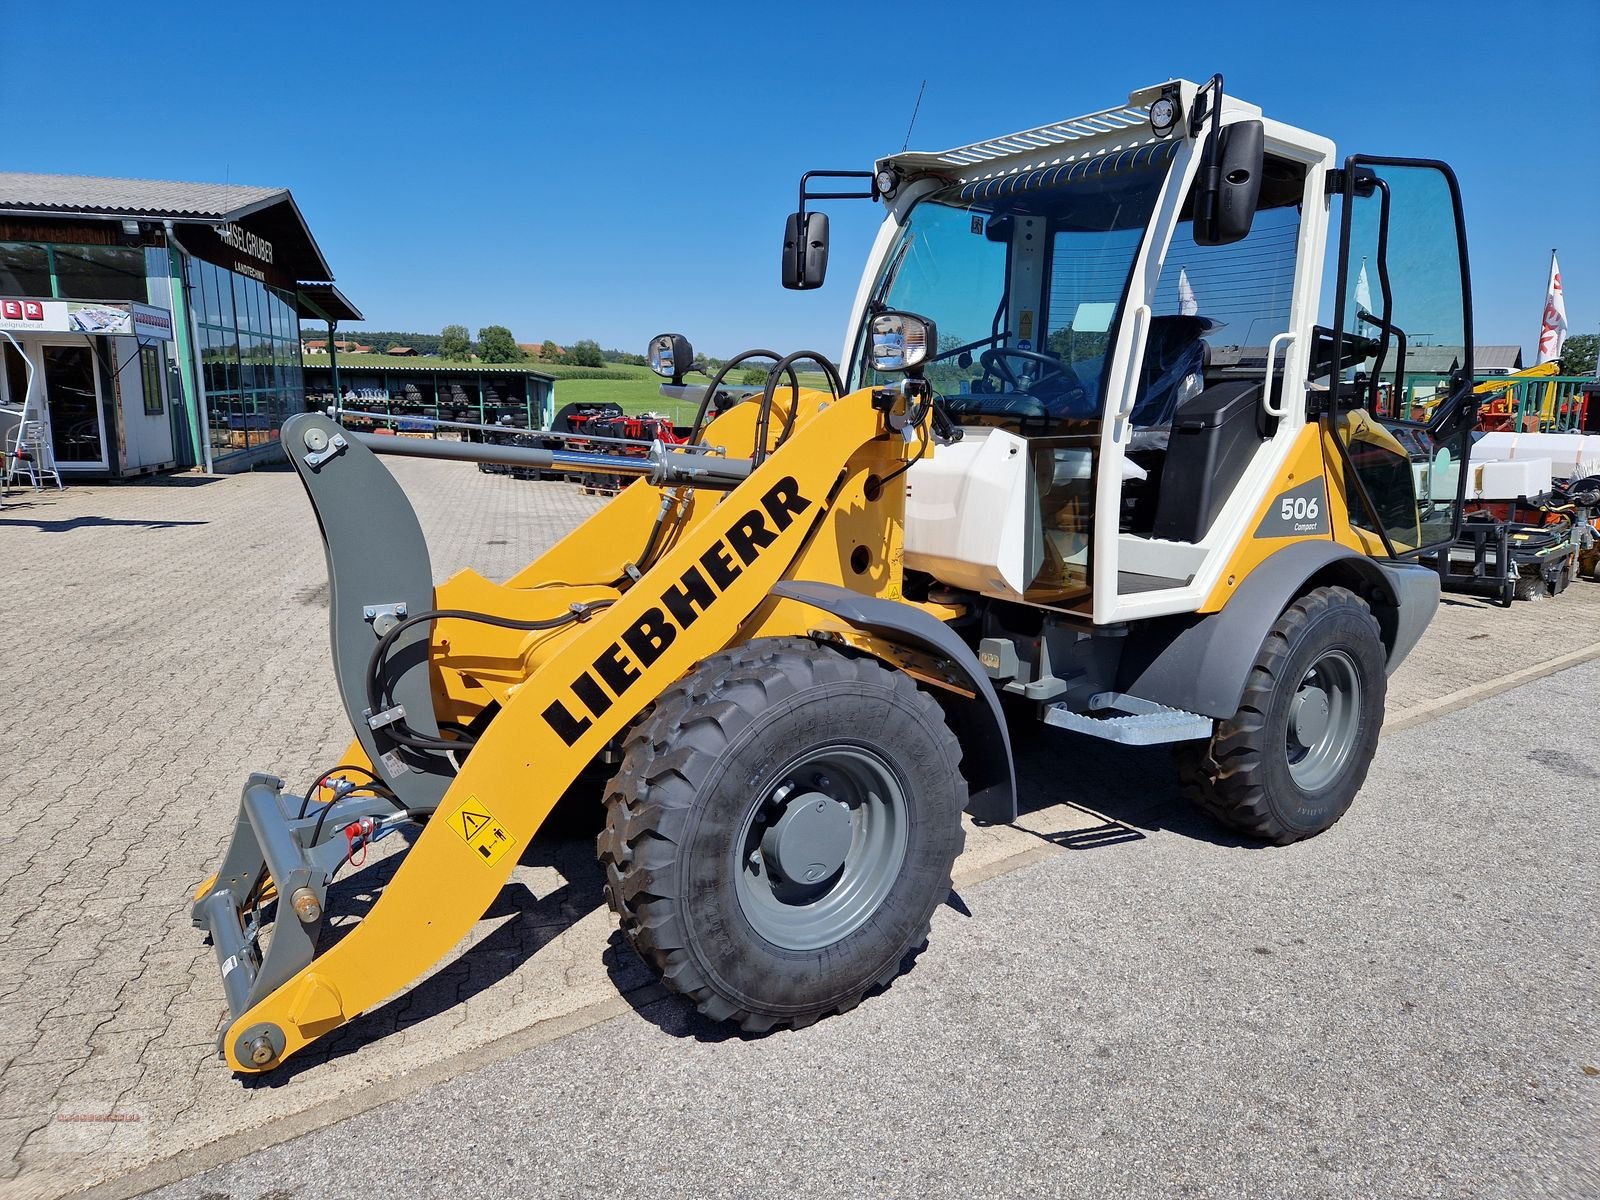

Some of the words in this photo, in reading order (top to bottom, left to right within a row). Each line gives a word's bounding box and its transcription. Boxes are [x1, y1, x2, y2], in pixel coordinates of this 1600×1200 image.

[1281, 497, 1319, 520] 506
[1294, 522, 1318, 532] Compact
[541, 476, 812, 747] LIEBHERR
